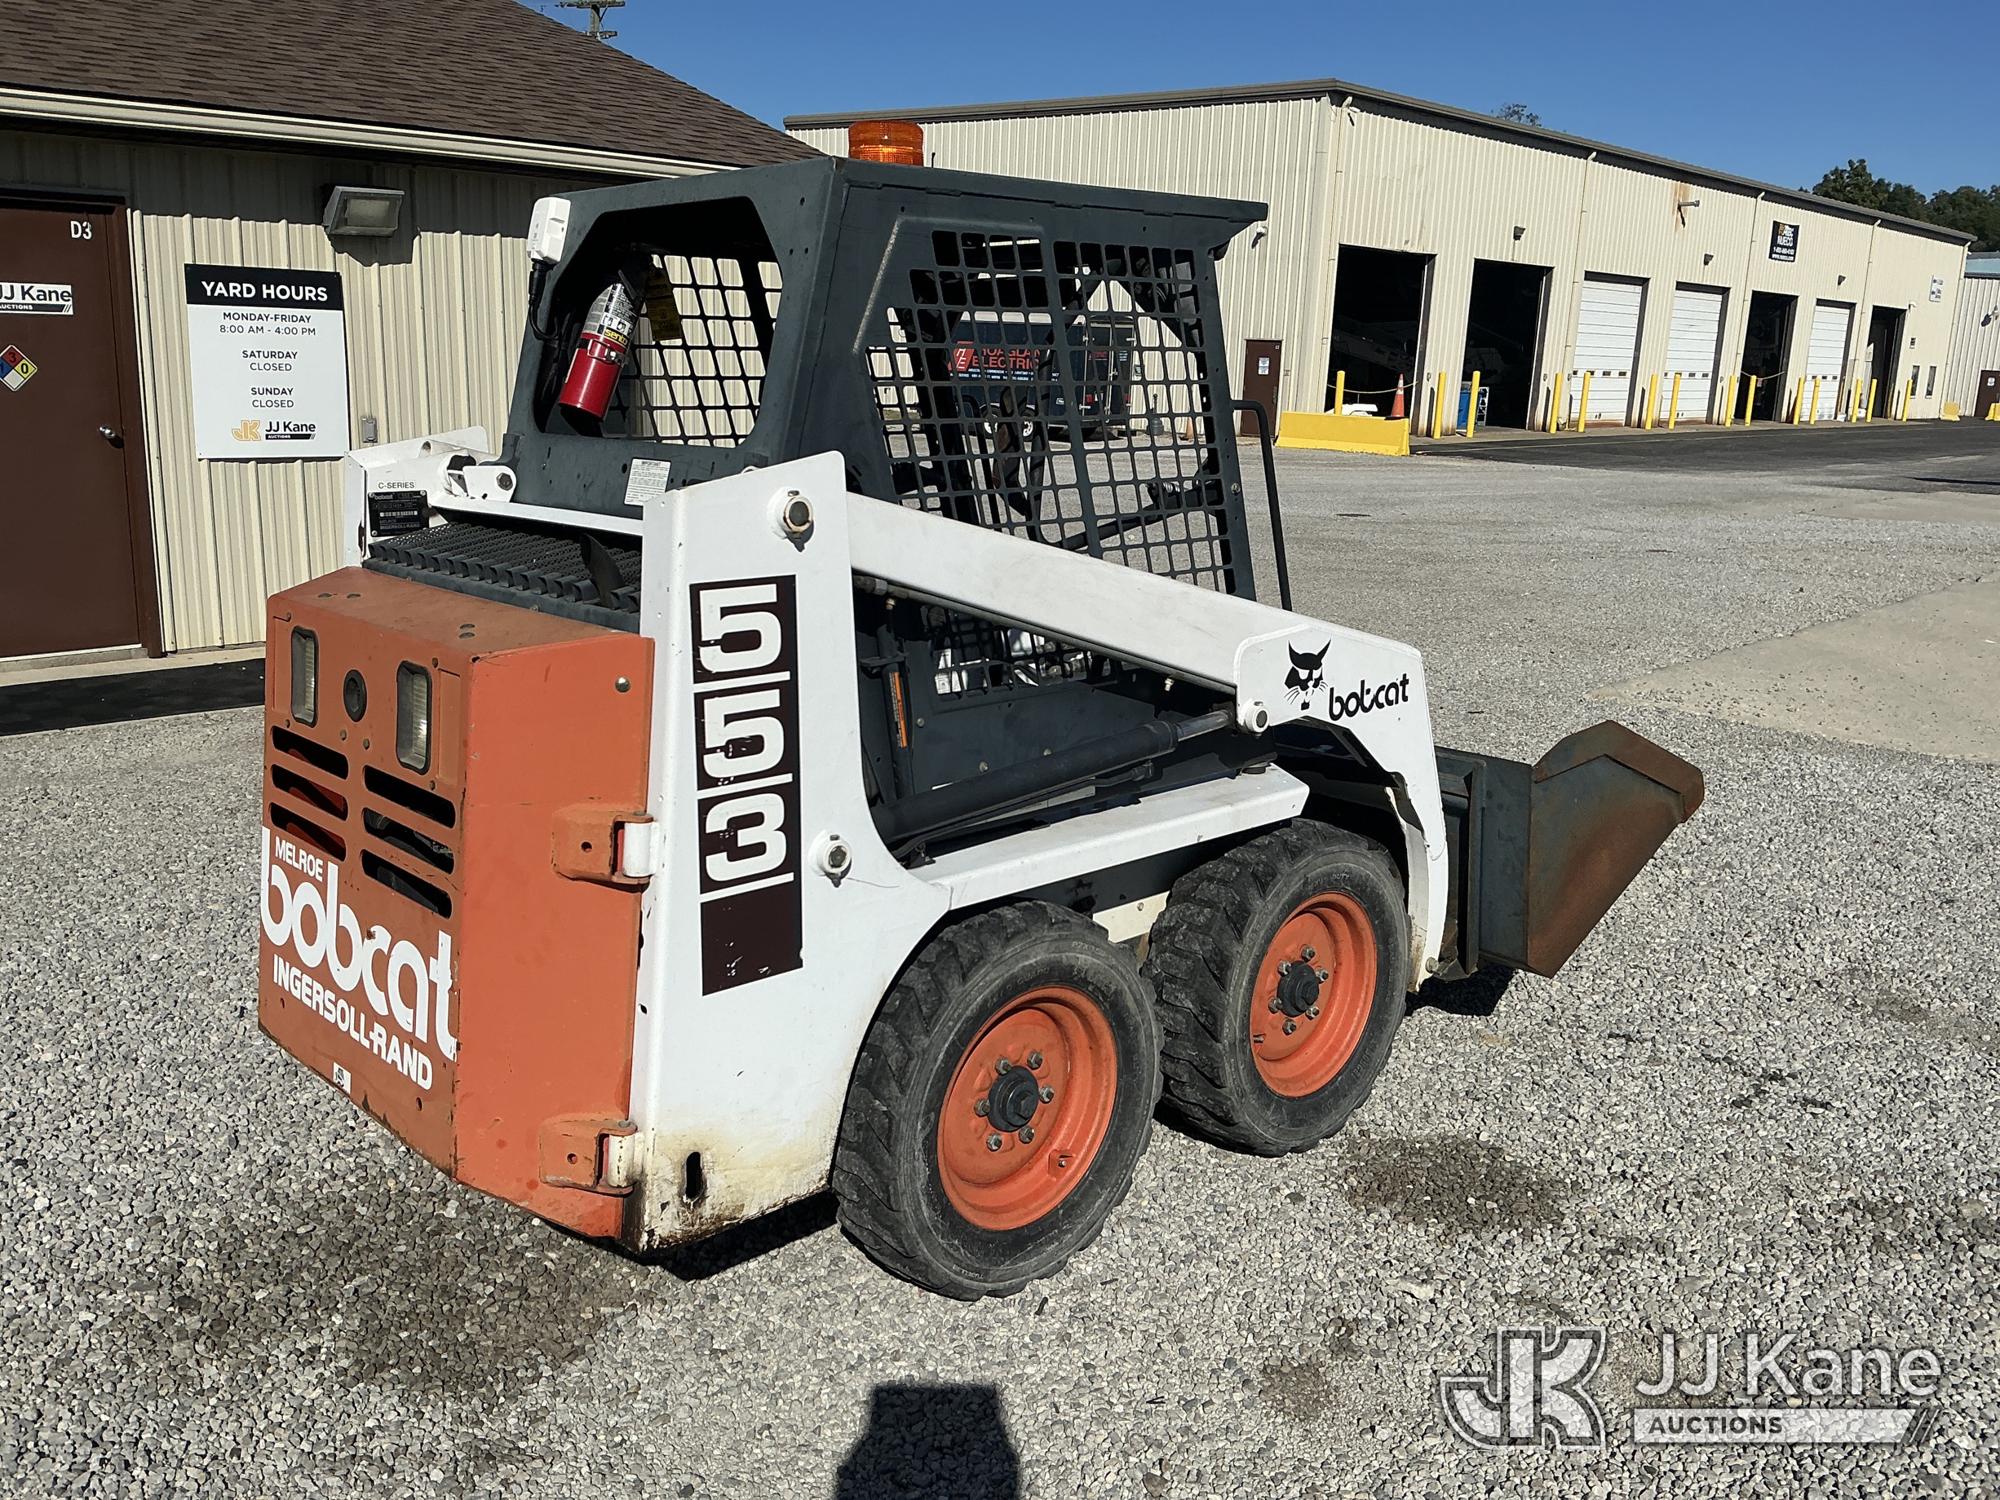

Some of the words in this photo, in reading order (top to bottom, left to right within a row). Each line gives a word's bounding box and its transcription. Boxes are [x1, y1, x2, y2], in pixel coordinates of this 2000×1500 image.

[70, 220, 92, 240] D3
[0, 283, 15, 301] J
[20, 284, 72, 302] Kane
[201, 281, 256, 298] YARD
[262, 284, 328, 301] HOURS
[223, 312, 312, 323] MONDAY-FRIDAY
[219, 325, 244, 334] 8:00
[248, 326, 264, 334] AM
[274, 327, 298, 335] 4:00
[301, 328, 316, 336] PM
[8, 351, 17, 363] 3
[242, 350, 298, 359] SATURDAY
[20, 363, 28, 375] 0
[250, 362, 292, 371] CLOSED
[251, 387, 294, 396] SUNDAY
[252, 399, 294, 408] CLOSED
[265, 421, 280, 432] JJ
[283, 421, 316, 432] Kane
[378, 481, 415, 489] C-SERIES
[1328, 673, 1410, 721] bobcat
[275, 836, 323, 882] MELROE
[261, 826, 458, 1062] bobcat
[273, 953, 433, 1091] INGERSOLL-RAND
